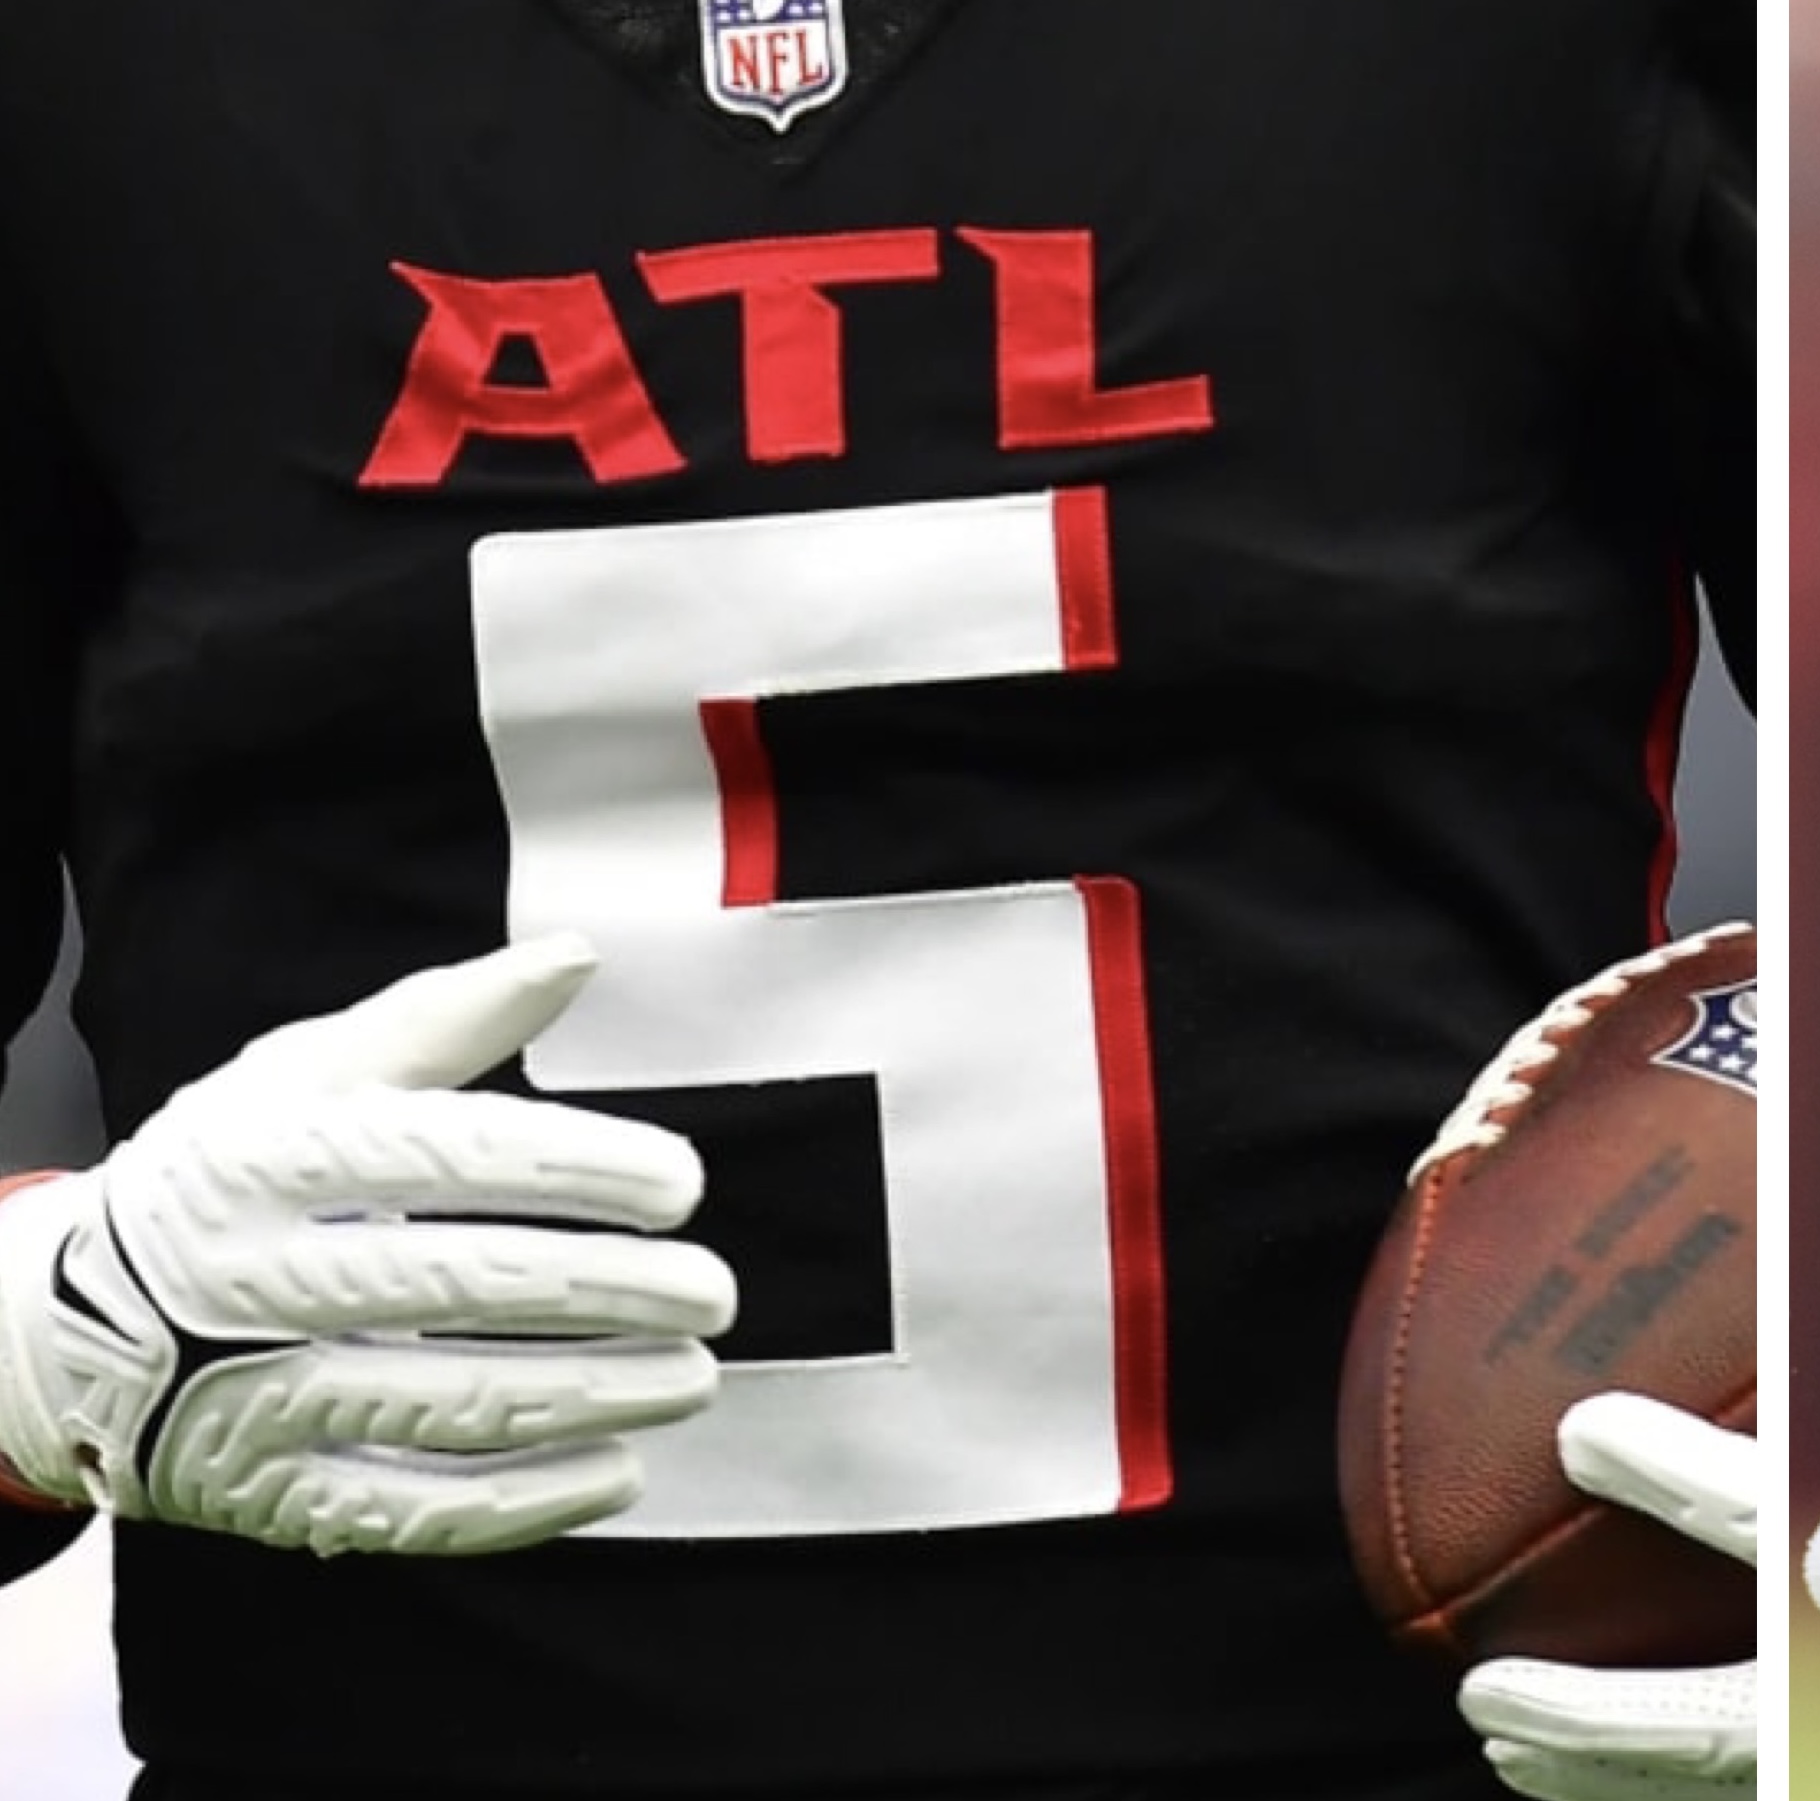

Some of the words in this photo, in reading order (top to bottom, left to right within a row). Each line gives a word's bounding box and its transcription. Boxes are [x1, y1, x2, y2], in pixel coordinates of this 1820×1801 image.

[726, 29, 824, 96] NFL
[357, 226, 1214, 487] ATL
[468, 484, 1174, 1539] 5
